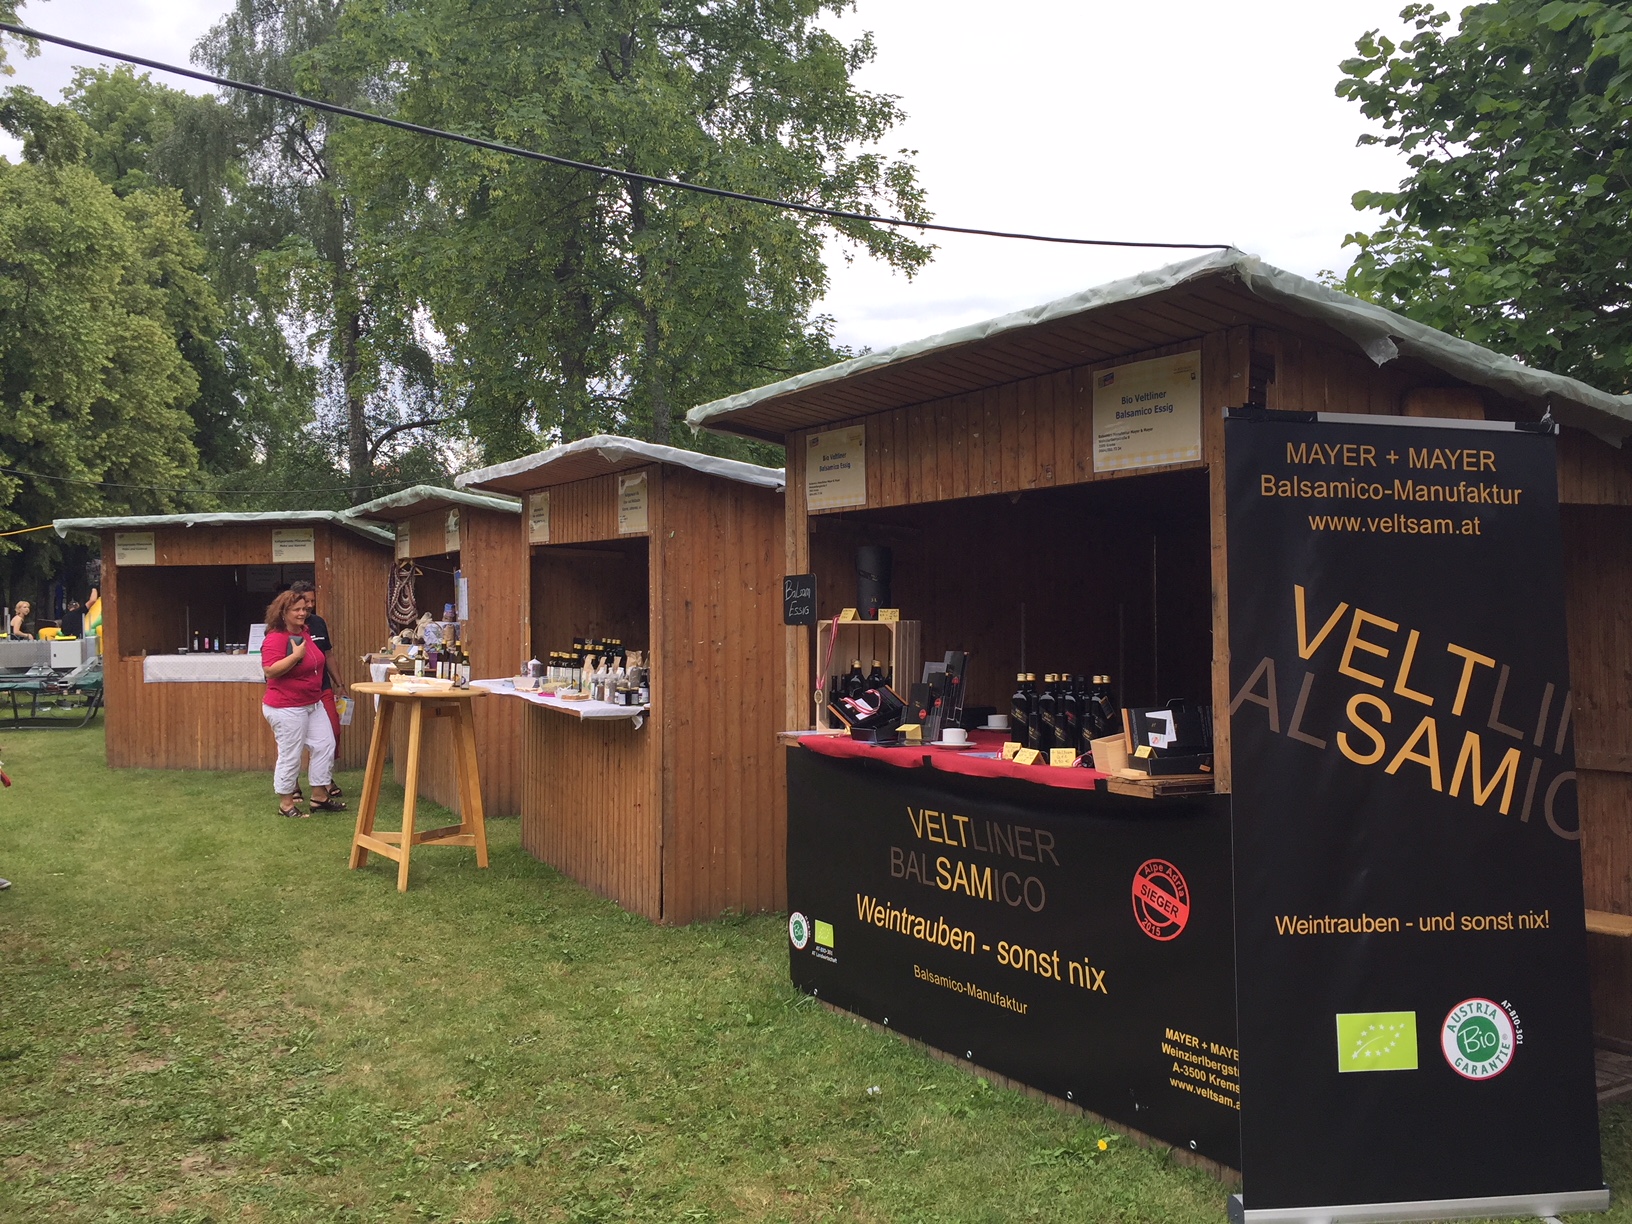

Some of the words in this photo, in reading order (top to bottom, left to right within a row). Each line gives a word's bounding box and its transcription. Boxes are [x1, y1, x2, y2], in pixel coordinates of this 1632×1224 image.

[1115, 407, 1153, 420] Balsamico
[1154, 403, 1174, 414] Essig
[1121, 396, 1133, 405] Bio
[1134, 391, 1167, 403] Veltliner
[1286, 442, 1377, 467] MAYER
[1385, 450, 1400, 465] +
[1408, 447, 1497, 472] MAYER
[1260, 474, 1523, 505] Balsamico-Manufaktur
[1308, 512, 1481, 536] www.veltsam.at
[907, 806, 1060, 867] VELTLINER
[890, 846, 1046, 912] BALSAMICO
[1144, 863, 1164, 875] Alpe
[1166, 868, 1185, 897] Adria
[1140, 884, 1180, 918] SIEGER
[1142, 918, 1161, 937] 2015
[1275, 913, 1400, 936] Weintrauben
[1418, 912, 1455, 932] und
[1460, 912, 1514, 931] sonst
[1518, 910, 1550, 930] nix!
[856, 893, 976, 955] Weintrauben
[997, 940, 1062, 982] sonst
[1068, 956, 1108, 995] nix
[913, 964, 1028, 1015] Balsamico-Manufaktur
[1446, 1002, 1498, 1034] AUSTRIA
[1500, 1000, 1524, 1045] AT-BIO-301
[1165, 1027, 1200, 1049] MAYER
[1201, 1041, 1208, 1050] +
[1458, 1026, 1496, 1054] Bio
[1454, 1042, 1510, 1076] GARANTIE
[1169, 1078, 1240, 1110] www.veltsam.a
[1172, 1062, 1207, 1082] A-3500
[1208, 1072, 1240, 1094] Krems
